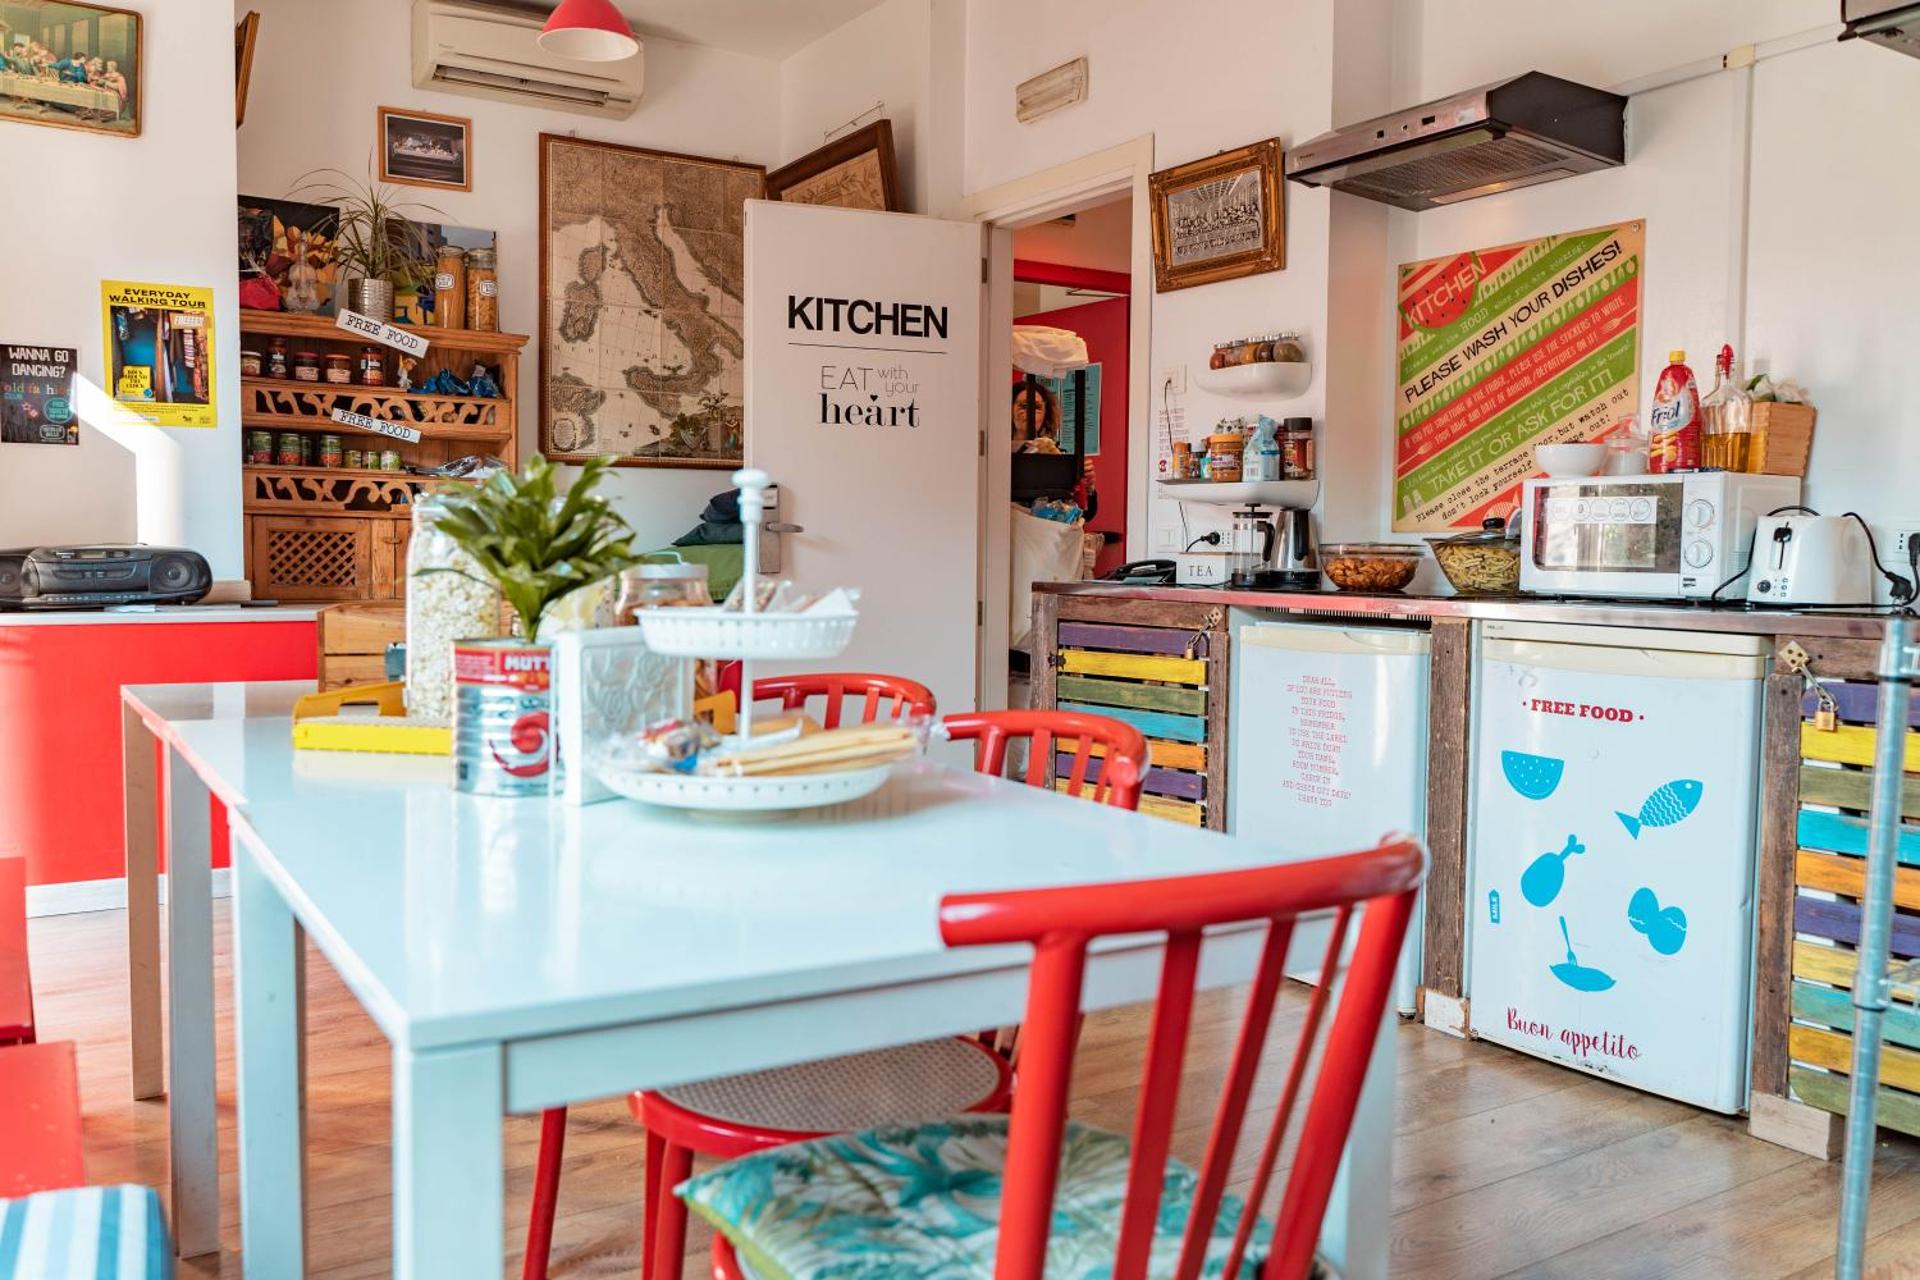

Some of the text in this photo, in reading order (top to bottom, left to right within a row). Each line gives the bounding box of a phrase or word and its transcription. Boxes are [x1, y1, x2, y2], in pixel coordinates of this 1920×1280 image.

[110, 295, 205, 308] WALKING TOUR
[124, 288, 190, 298] EVERYDAY
[1407, 260, 1484, 325] KITCHEN
[788, 295, 947, 338] KITCHEN
[1406, 241, 1620, 401] PLEASE WASH YOUR DISHES!
[1460, 308, 1488, 332] HOOD
[345, 315, 418, 348] FREE FOOD
[1508, 357, 1531, 378] PLEASE
[1531, 348, 1545, 362] USE
[1545, 339, 1559, 353] THE
[1559, 318, 1590, 344] STICKERS
[1601, 295, 1624, 316] WRITE
[9, 347, 69, 362] WANNA GO
[12, 364, 65, 378] DANCING?
[821, 364, 908, 391] EAT with
[885, 382, 920, 397] your
[340, 410, 410, 438] FREE FOOD
[818, 393, 920, 428] heart
[1588, 413, 1610, 432] out!
[1428, 458, 1468, 493] TAKE
[1467, 447, 1487, 468] IT
[1486, 430, 1514, 456] OR
[1514, 408, 1549, 439] ASK
[1549, 384, 1587, 417] FOR
[1587, 368, 1614, 393] IT!
[1416, 500, 1443, 522] Please
[1447, 484, 1470, 504] close
[1475, 472, 1489, 486] the
[1494, 448, 1527, 476] terrace
[1578, 402, 1606, 425] watch
[1610, 388, 1628, 404] out
[1441, 460, 1532, 520] don't lock yourself
[1189, 565, 1213, 576] TEA
[1531, 699, 1633, 722] FREE FOOD
[1507, 1007, 1643, 1060] Buon appetito
